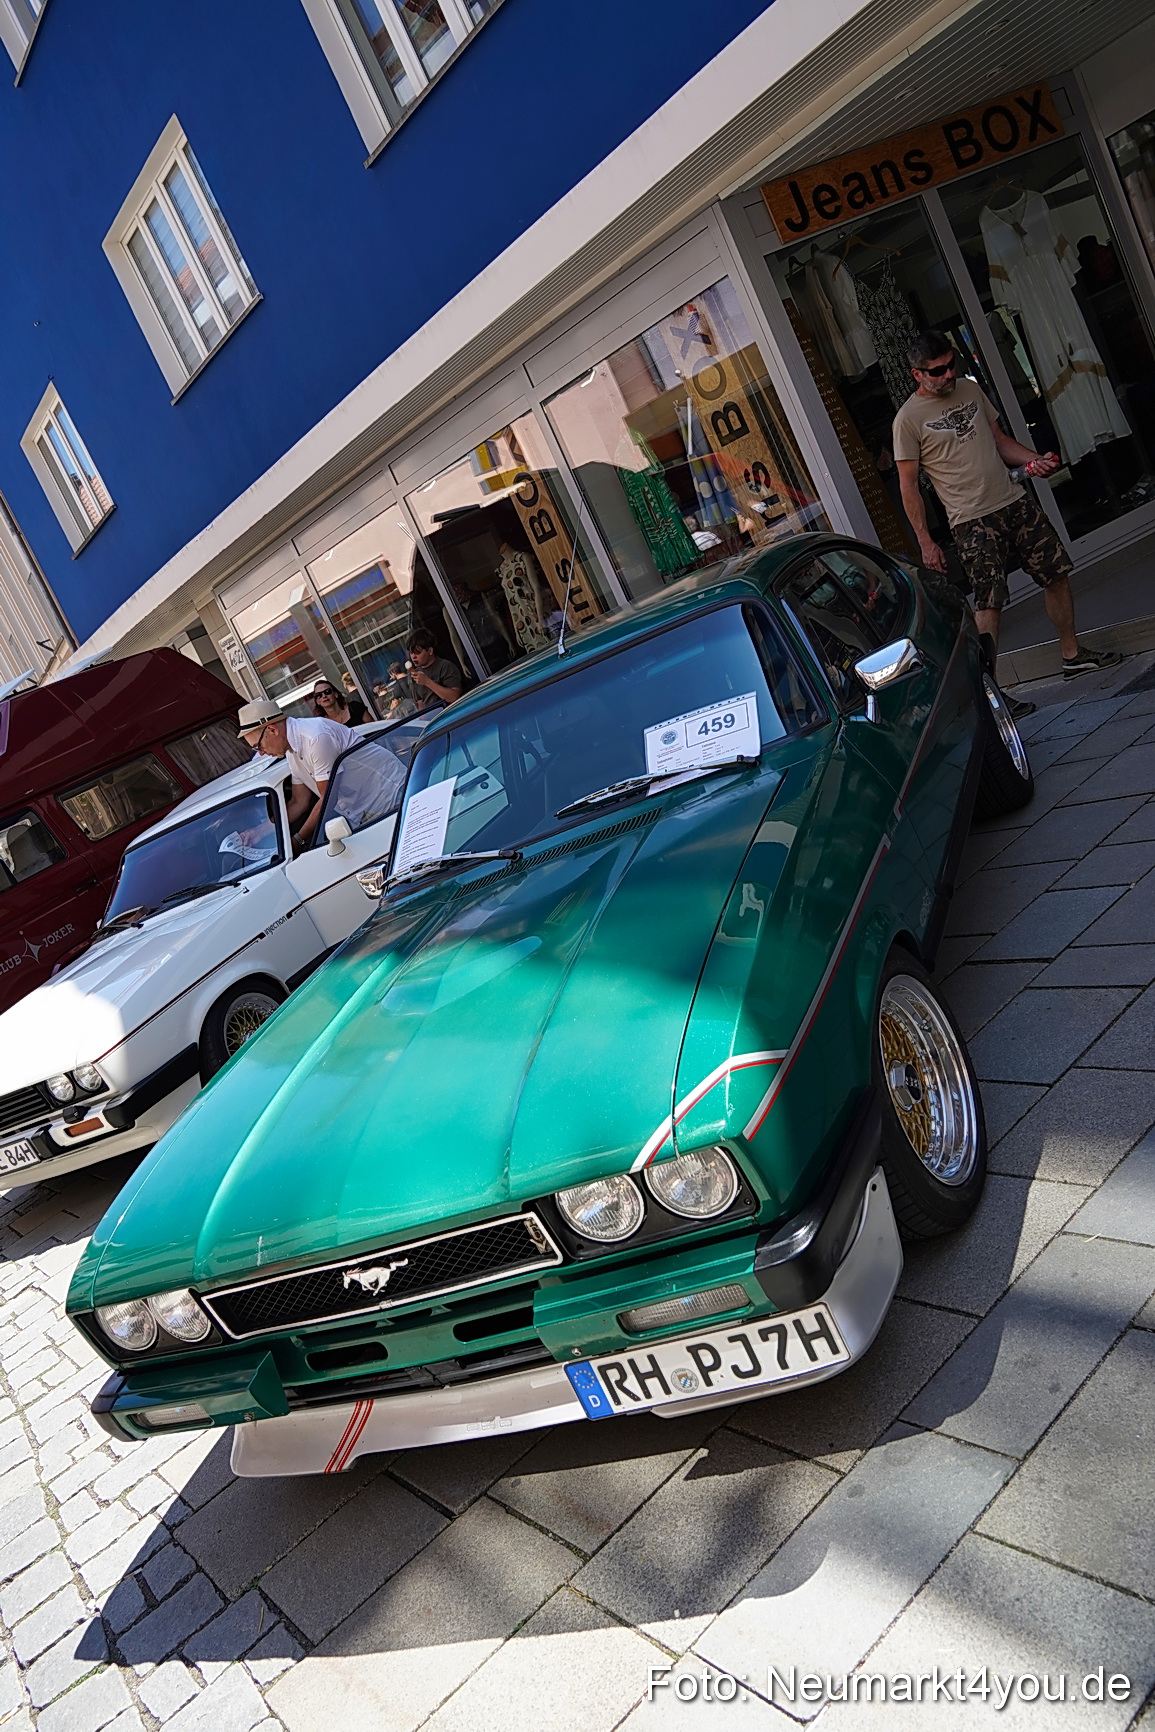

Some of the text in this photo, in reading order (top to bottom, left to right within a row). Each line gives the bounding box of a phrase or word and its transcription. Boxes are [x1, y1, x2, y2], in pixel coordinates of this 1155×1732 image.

[784, 89, 1058, 233] Jeans BOX
[670, 326, 750, 448] BOX
[697, 712, 736, 736] 459
[42, 923, 76, 948] JOKER
[4, 1142, 37, 1166] 84H
[598, 1311, 841, 1406] RH PJ7H
[588, 1394, 601, 1408] D
